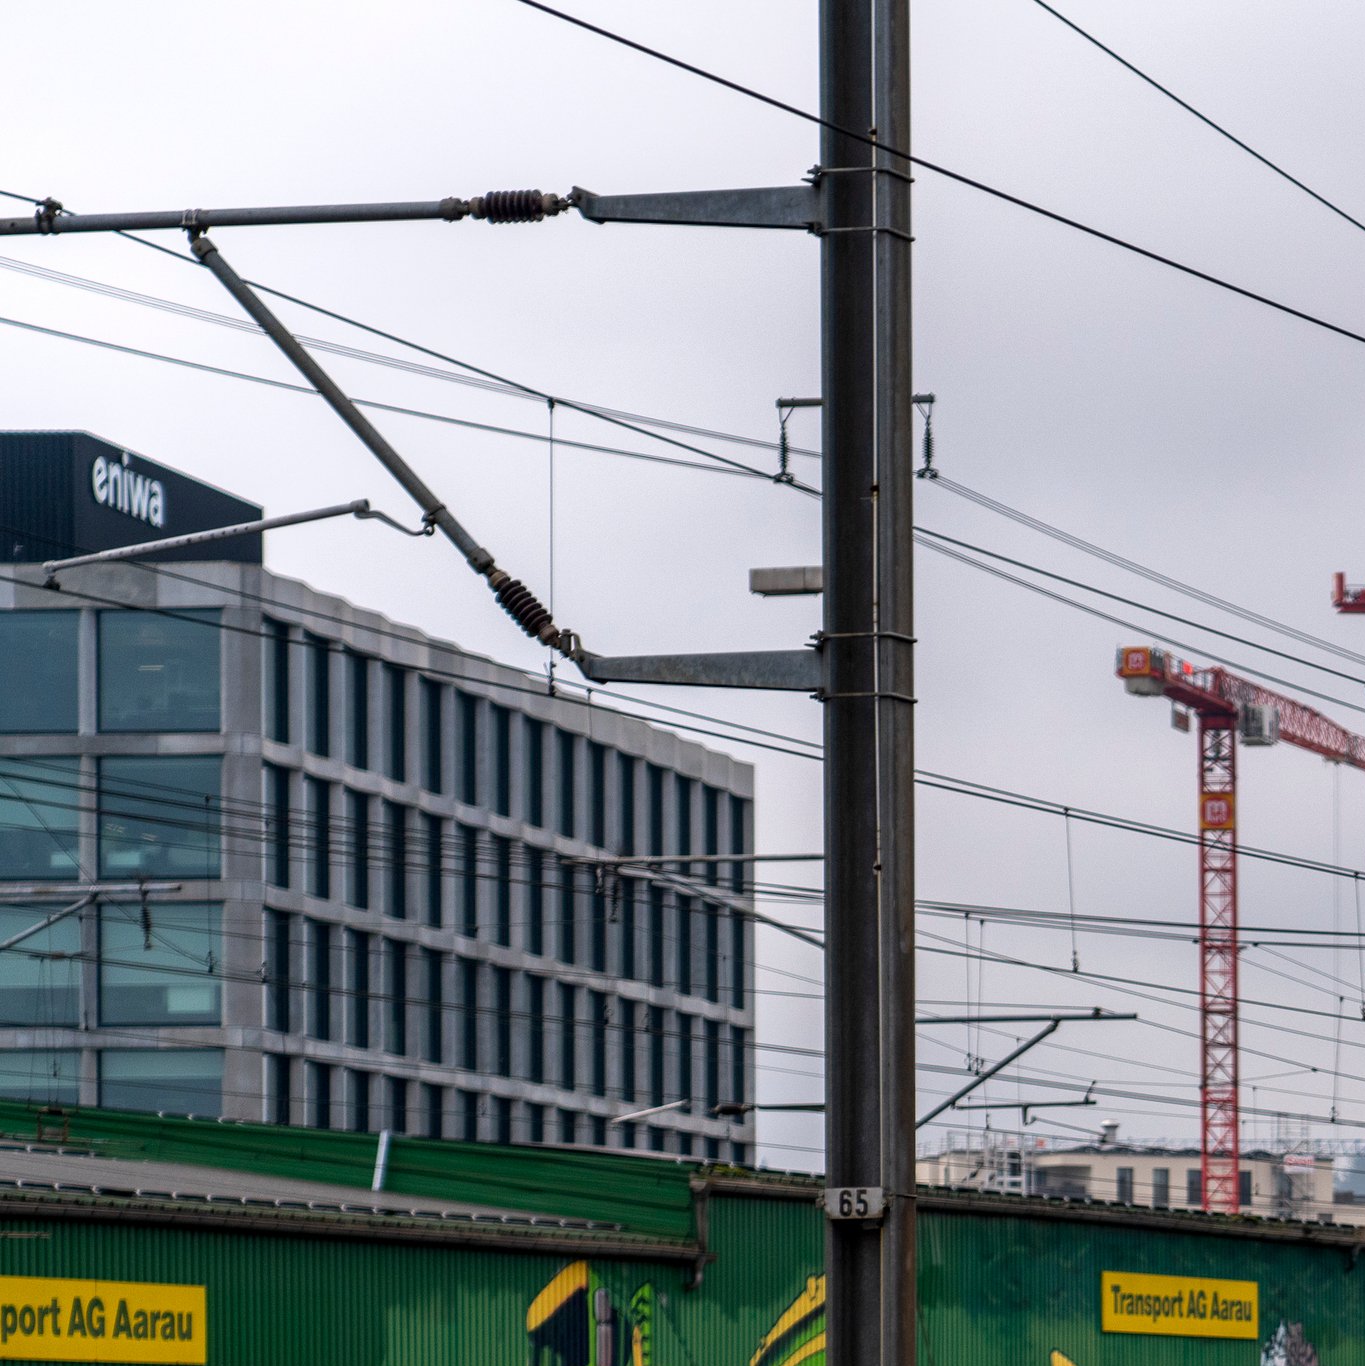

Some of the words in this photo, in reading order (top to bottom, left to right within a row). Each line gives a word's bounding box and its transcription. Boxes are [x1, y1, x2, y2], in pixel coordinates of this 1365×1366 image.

[92, 451, 164, 528] eniwa
[839, 1189, 868, 1217] 65
[67, 1297, 105, 1338] AG
[112, 1298, 192, 1341] Aarau
[1111, 1285, 1183, 1322] Transport
[1187, 1290, 1207, 1318] AG
[1211, 1291, 1252, 1321] Aarau
